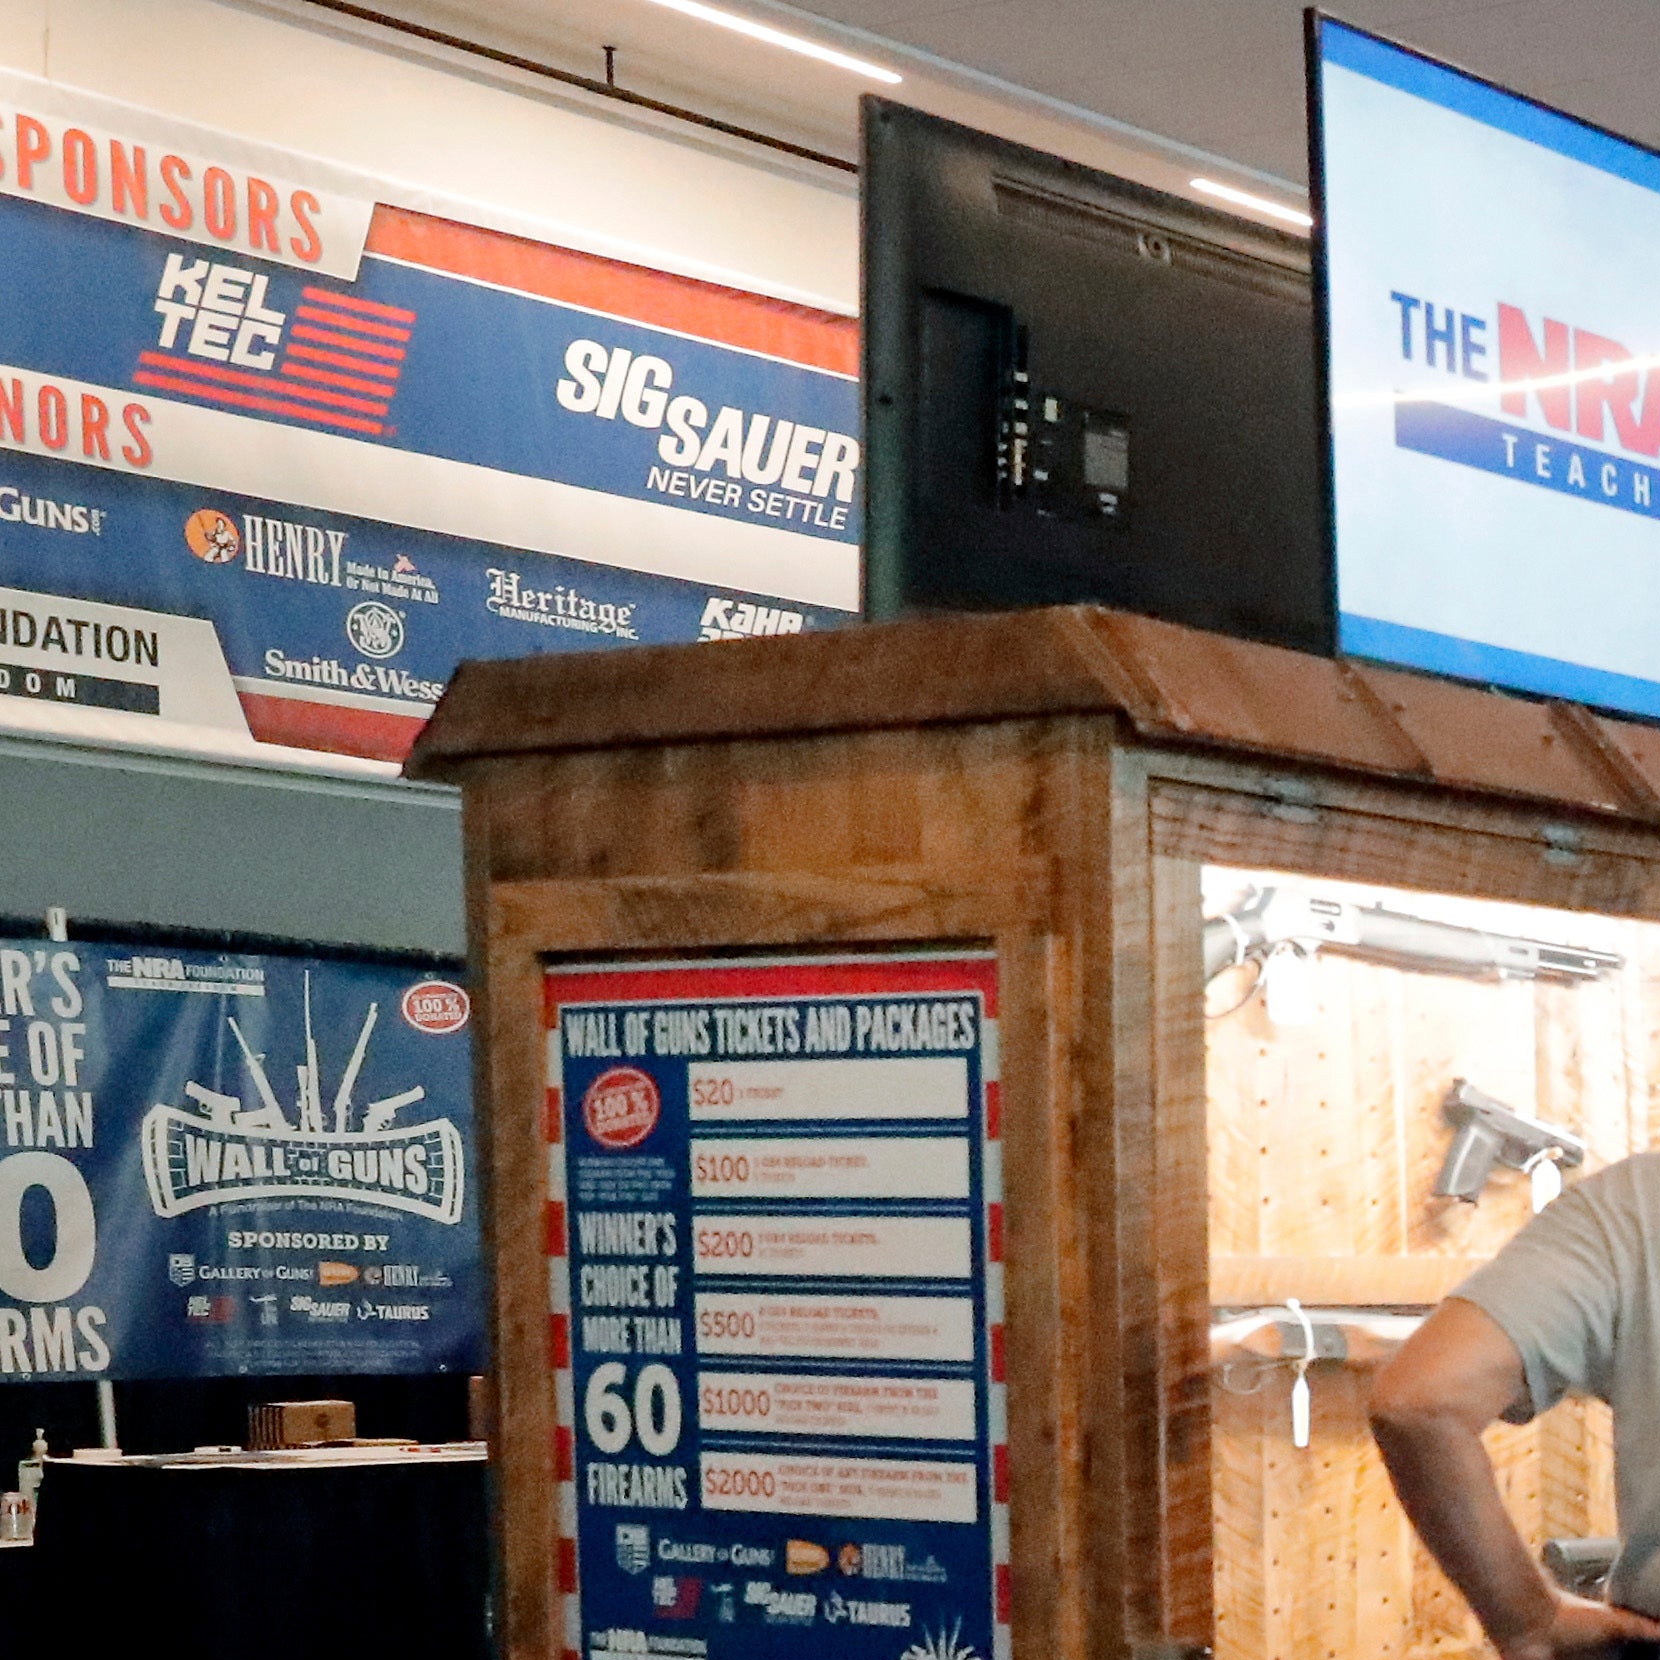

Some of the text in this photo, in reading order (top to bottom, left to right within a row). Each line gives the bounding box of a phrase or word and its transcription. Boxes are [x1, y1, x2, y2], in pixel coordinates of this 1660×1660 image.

[0, 113, 323, 263] PONSORS
[158, 252, 286, 326] KEL
[154, 298, 283, 371] TEC
[1390, 290, 1489, 382] THE
[556, 339, 861, 504] SIG SAUER
[646, 466, 849, 531] NEVER SETTLE
[1501, 431, 1652, 509] TEACH
[243, 513, 348, 588] HENRY
[486, 567, 634, 633] Heritage
[499, 605, 599, 634] MANUFACTURING
[0, 607, 160, 668] DATION
[106, 959, 132, 974] THE
[132, 956, 186, 981] NRA
[27, 1020, 87, 1087] OF
[565, 1001, 976, 1057] WALL OF GUNS TICKETS AND PACKAGES
[692, 1077, 735, 1107] $20
[185, 1133, 290, 1187] WALL
[327, 1143, 429, 1195] GUNS
[696, 1154, 750, 1183] $100
[228, 1231, 390, 1251] SPONSORED BY
[576, 1211, 678, 1257] WINNER'S
[698, 1230, 754, 1259] $200
[700, 1307, 756, 1338] $500
[584, 1360, 683, 1457] 60
[702, 1385, 772, 1417] $1000
[587, 1461, 689, 1510] FIREARMS
[704, 1466, 776, 1499] $2000
